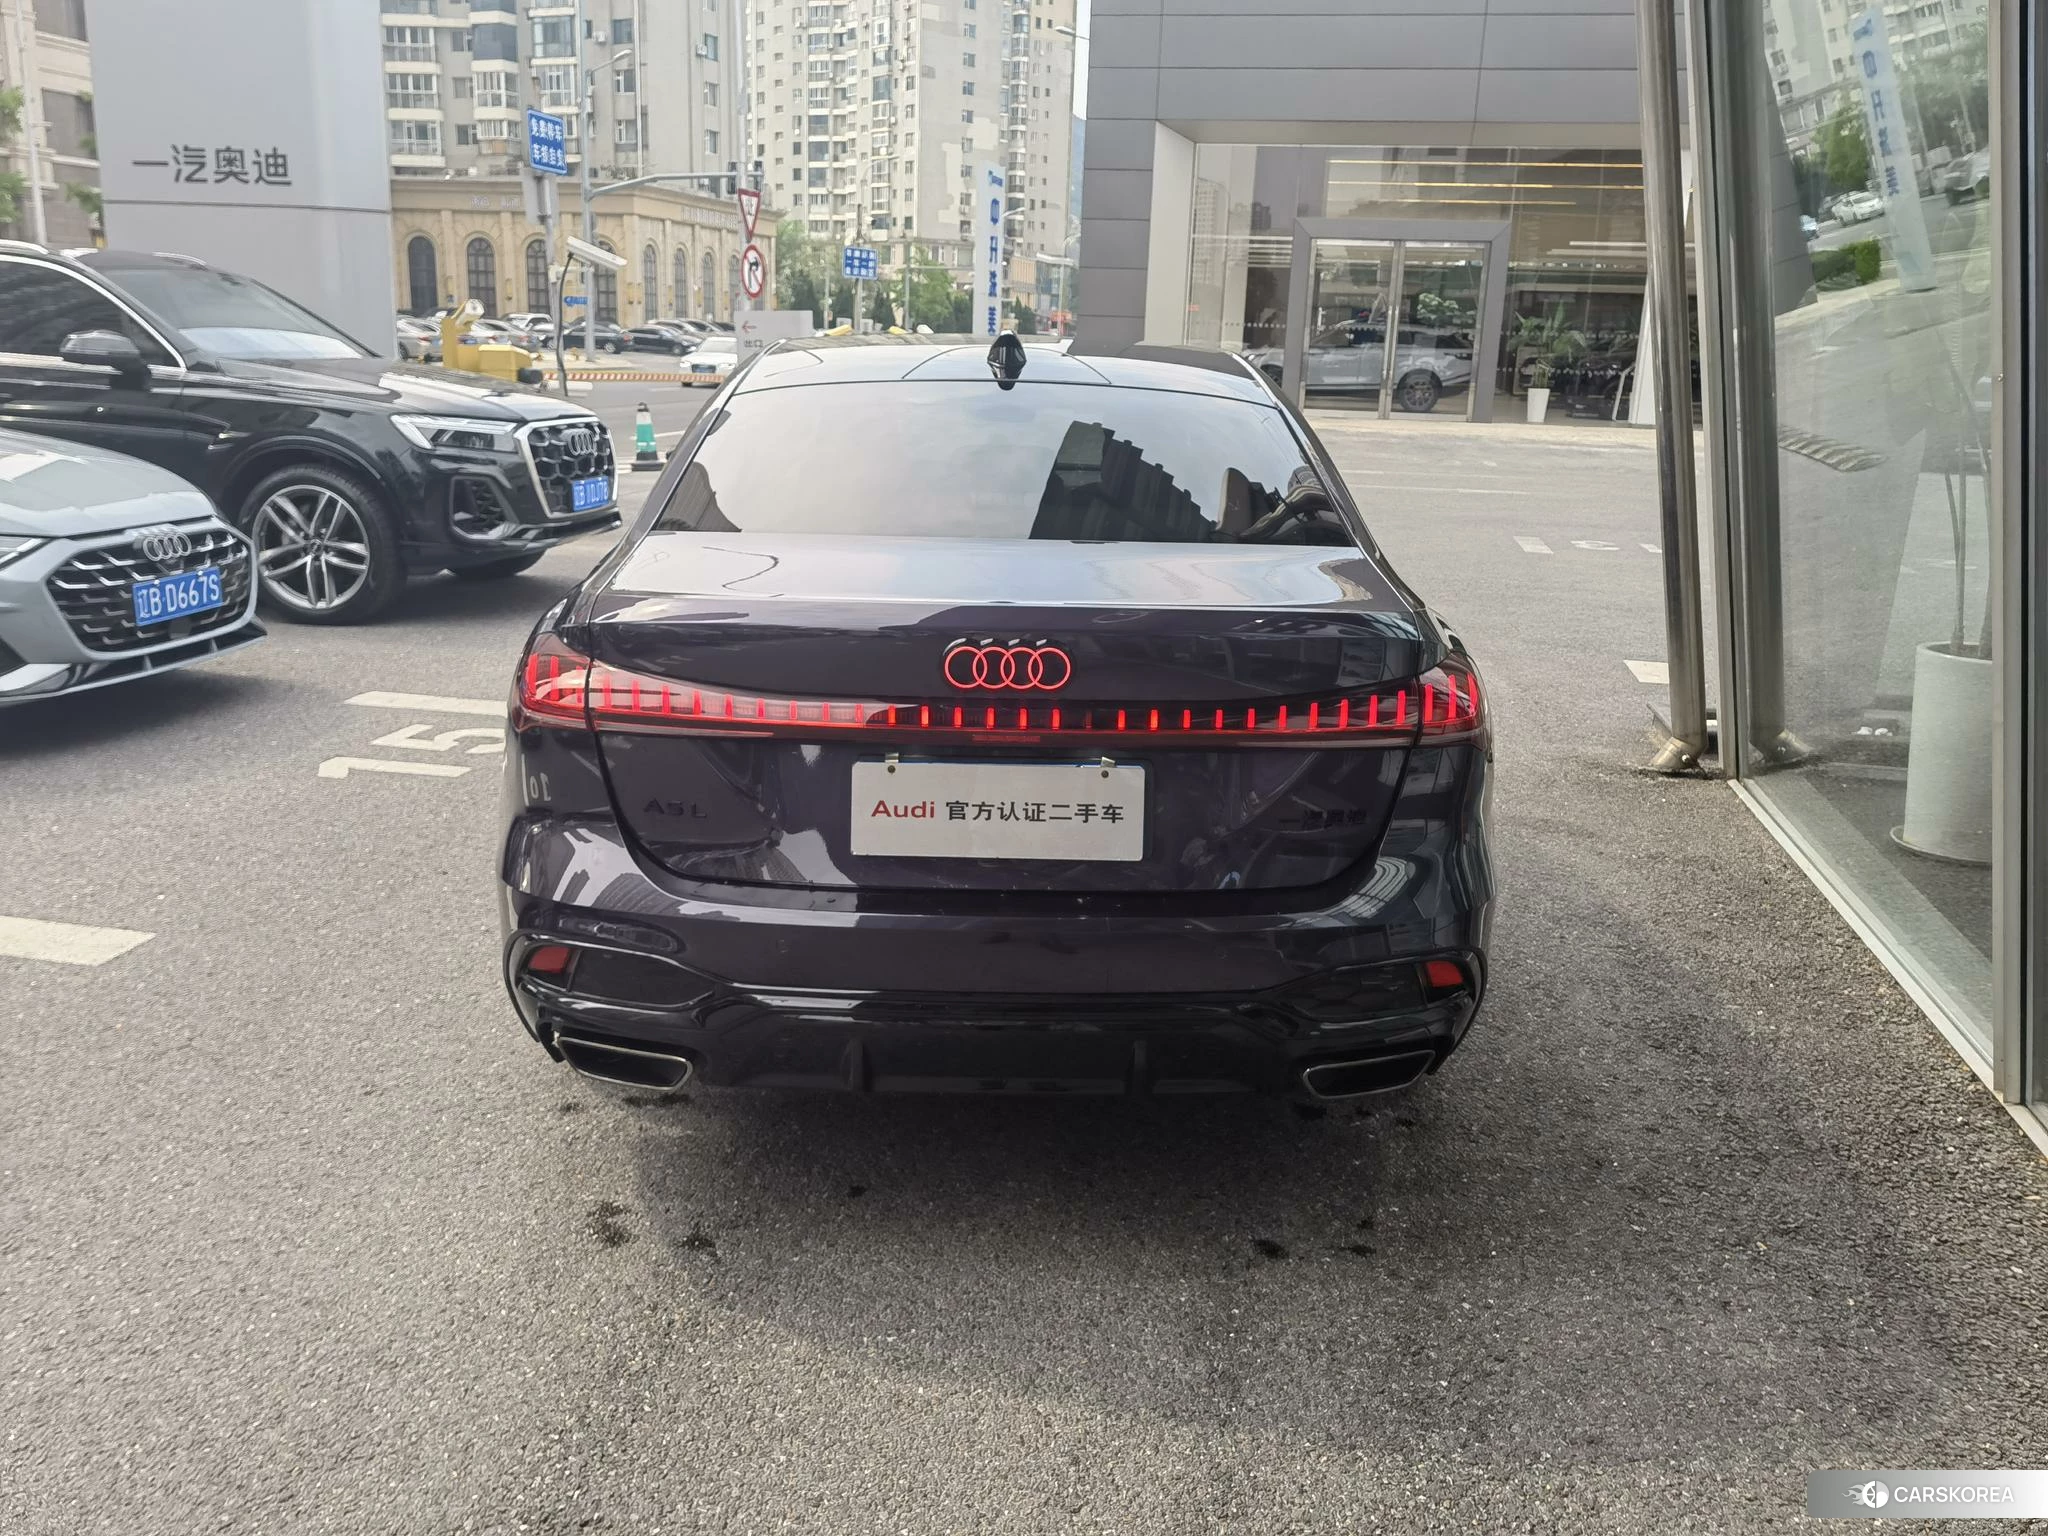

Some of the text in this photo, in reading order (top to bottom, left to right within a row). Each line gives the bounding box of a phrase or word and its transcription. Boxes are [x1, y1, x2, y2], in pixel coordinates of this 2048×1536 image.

[132, 144, 292, 186] 一汽奥迪
[871, 800, 1124, 823] Audi 官方认证二手车
